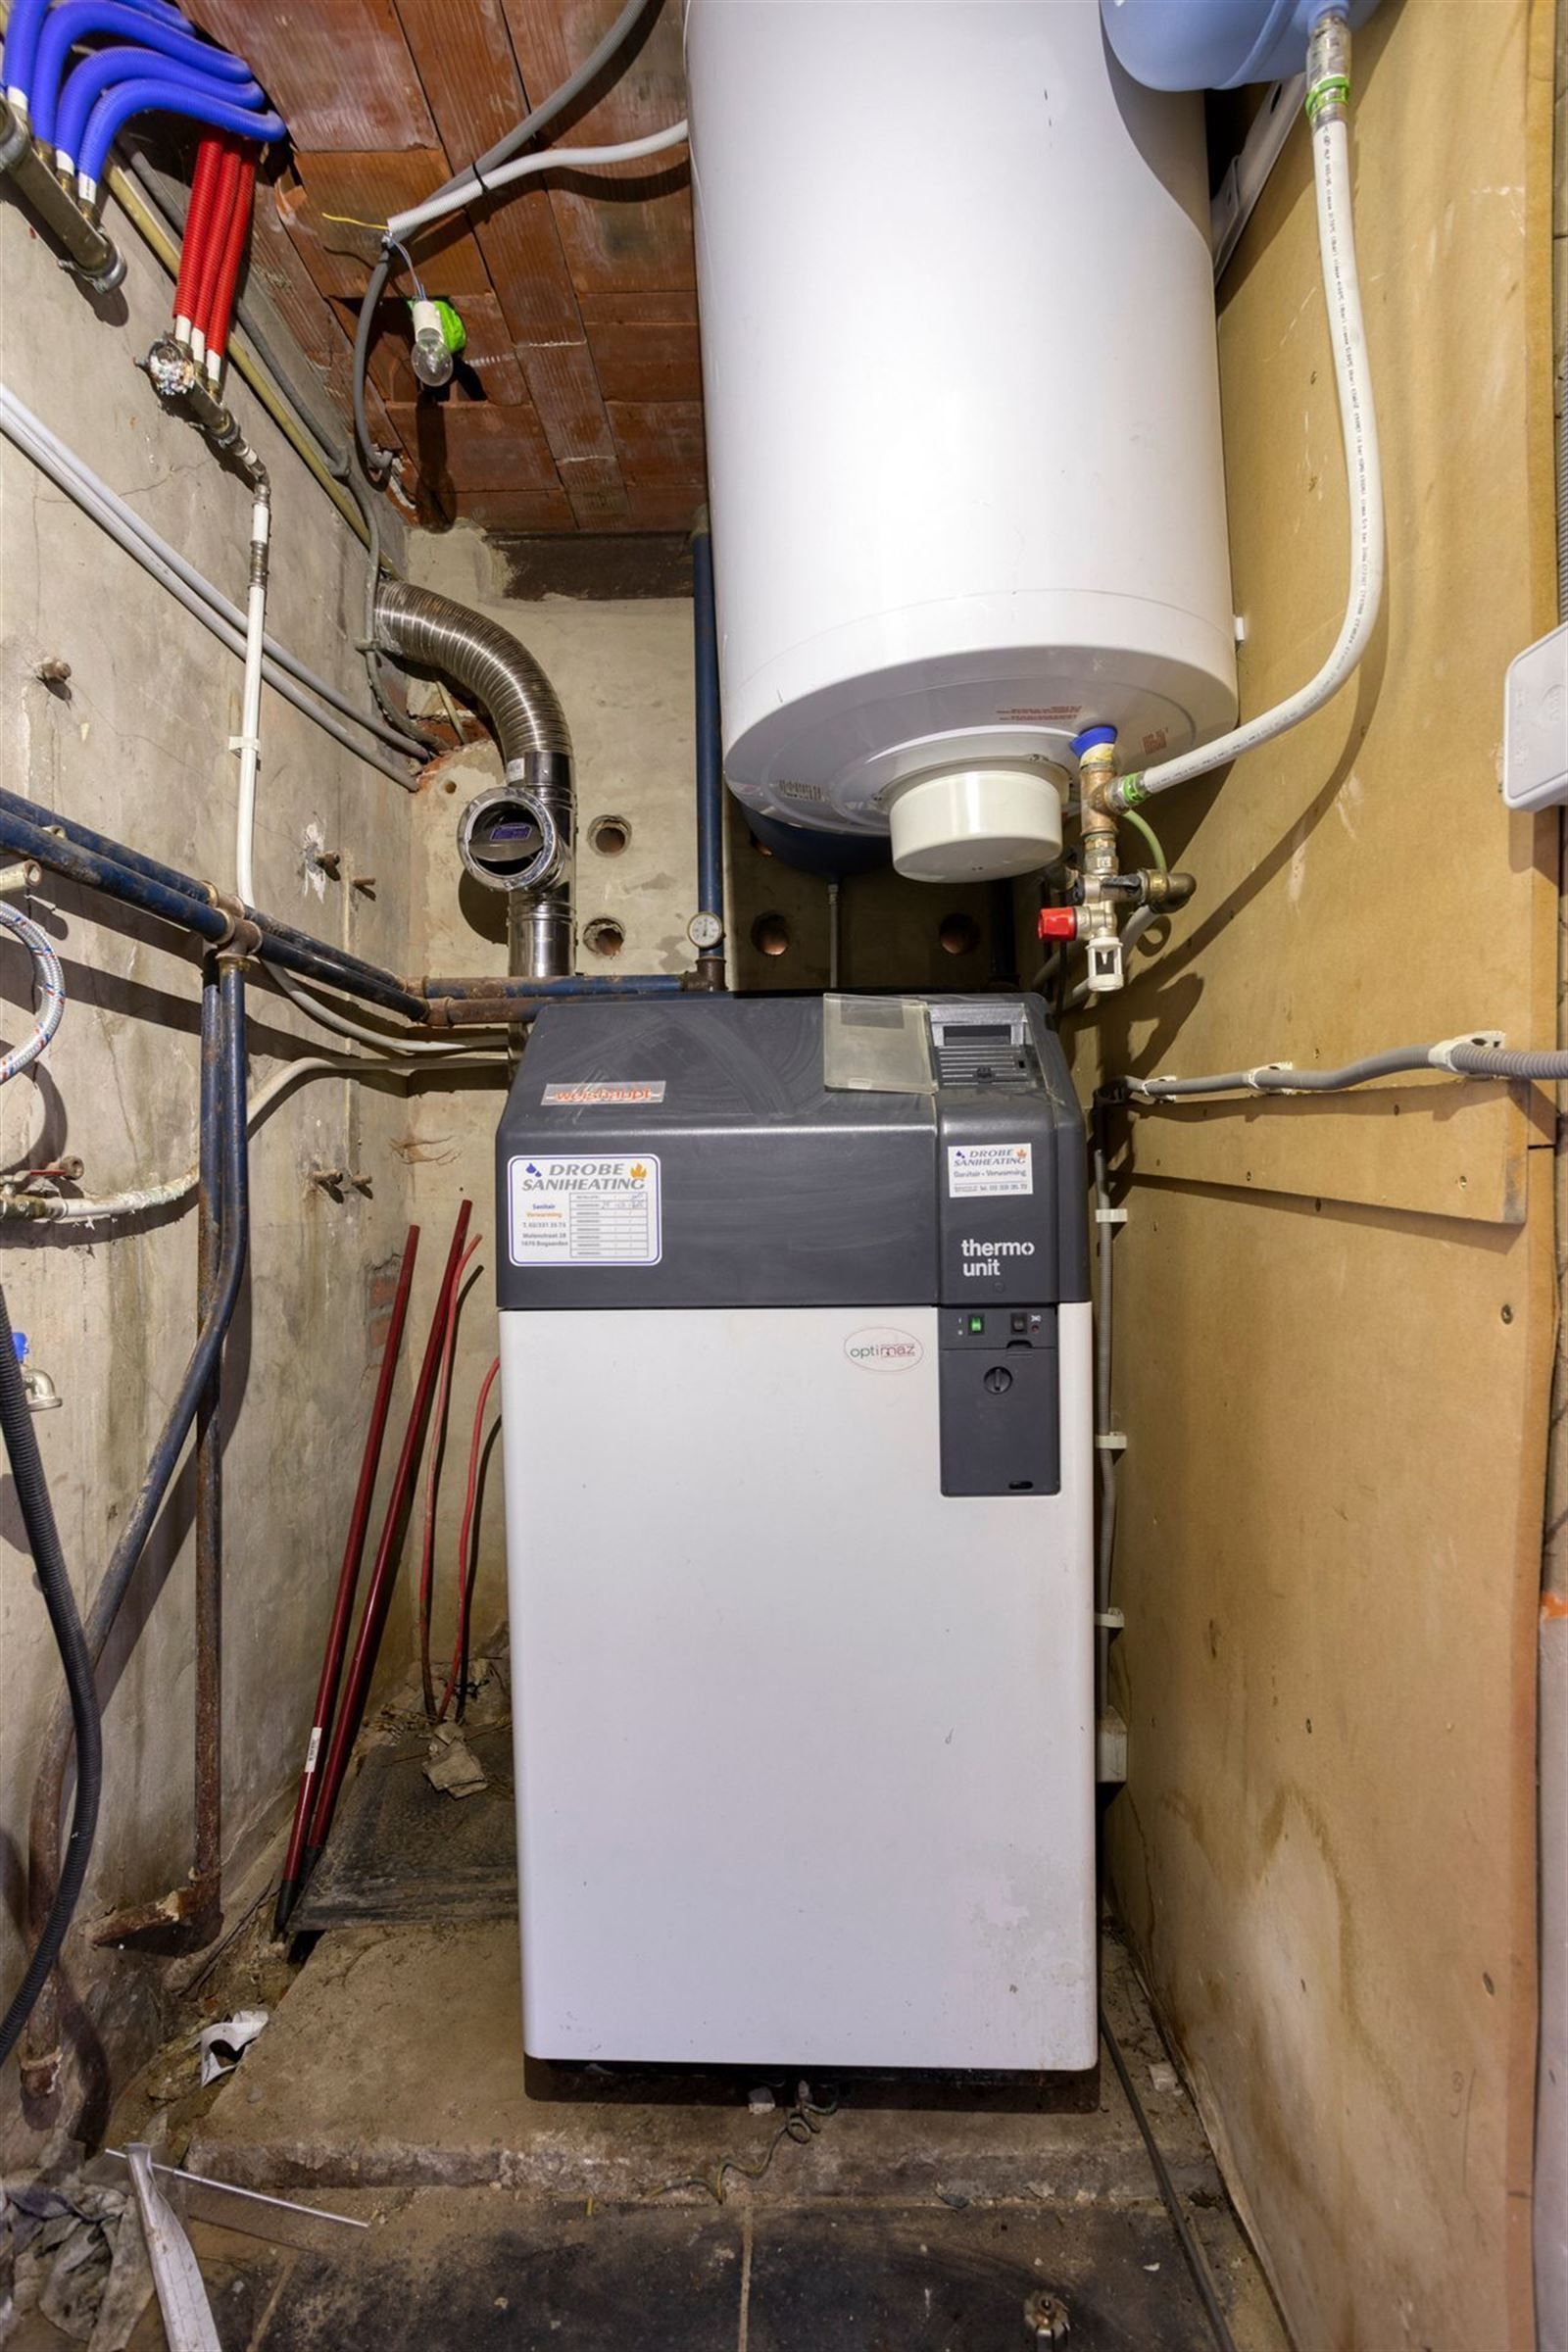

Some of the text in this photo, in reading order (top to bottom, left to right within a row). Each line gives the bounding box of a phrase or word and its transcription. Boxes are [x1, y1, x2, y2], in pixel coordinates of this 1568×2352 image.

[557, 1089, 652, 1102] weishaupt
[969, 1149, 1014, 1158] DROBE
[954, 1157, 1026, 1167] SANIHEATING
[549, 1163, 625, 1176] DROBE
[521, 1178, 646, 1192] SANIHEATING
[960, 1239, 1035, 1257] thermo
[963, 1258, 1001, 1277] unit
[850, 1344, 915, 1360] optimaz
